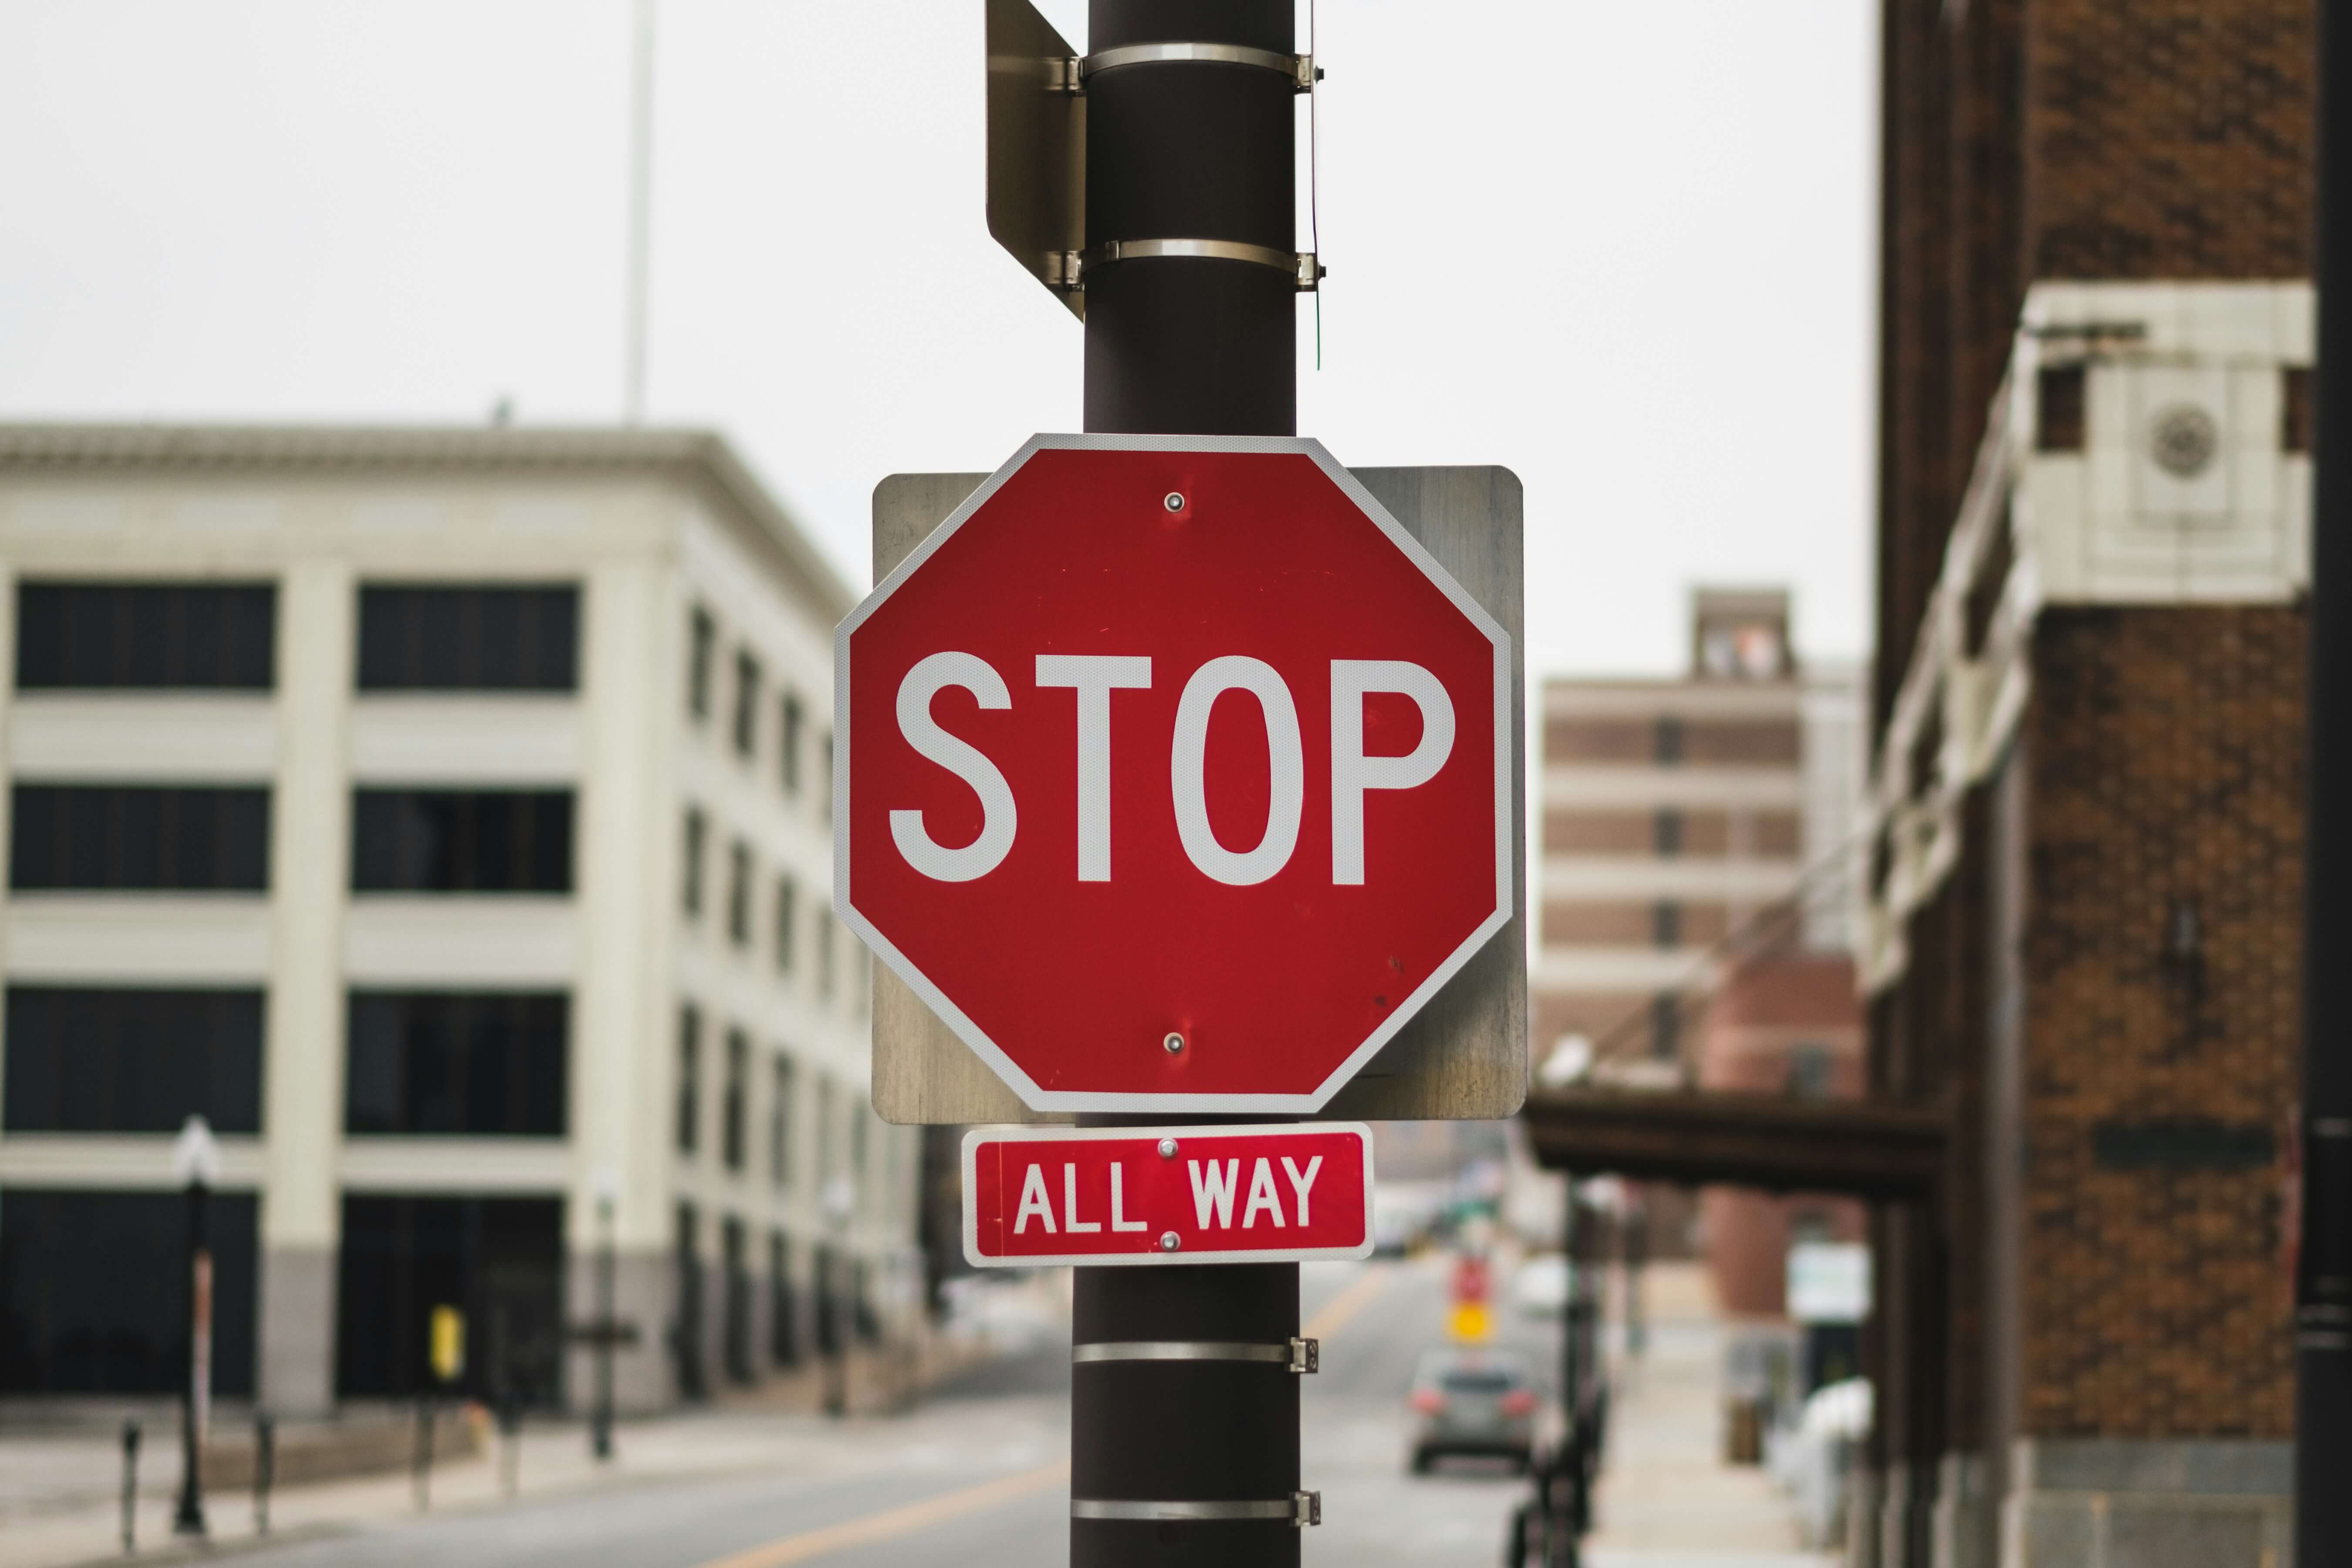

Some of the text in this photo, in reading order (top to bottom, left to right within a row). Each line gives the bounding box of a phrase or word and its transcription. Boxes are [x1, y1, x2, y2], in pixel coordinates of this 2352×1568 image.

[890, 651, 1455, 886] STOP
[1014, 1156, 1323, 1234] ALL WAY
